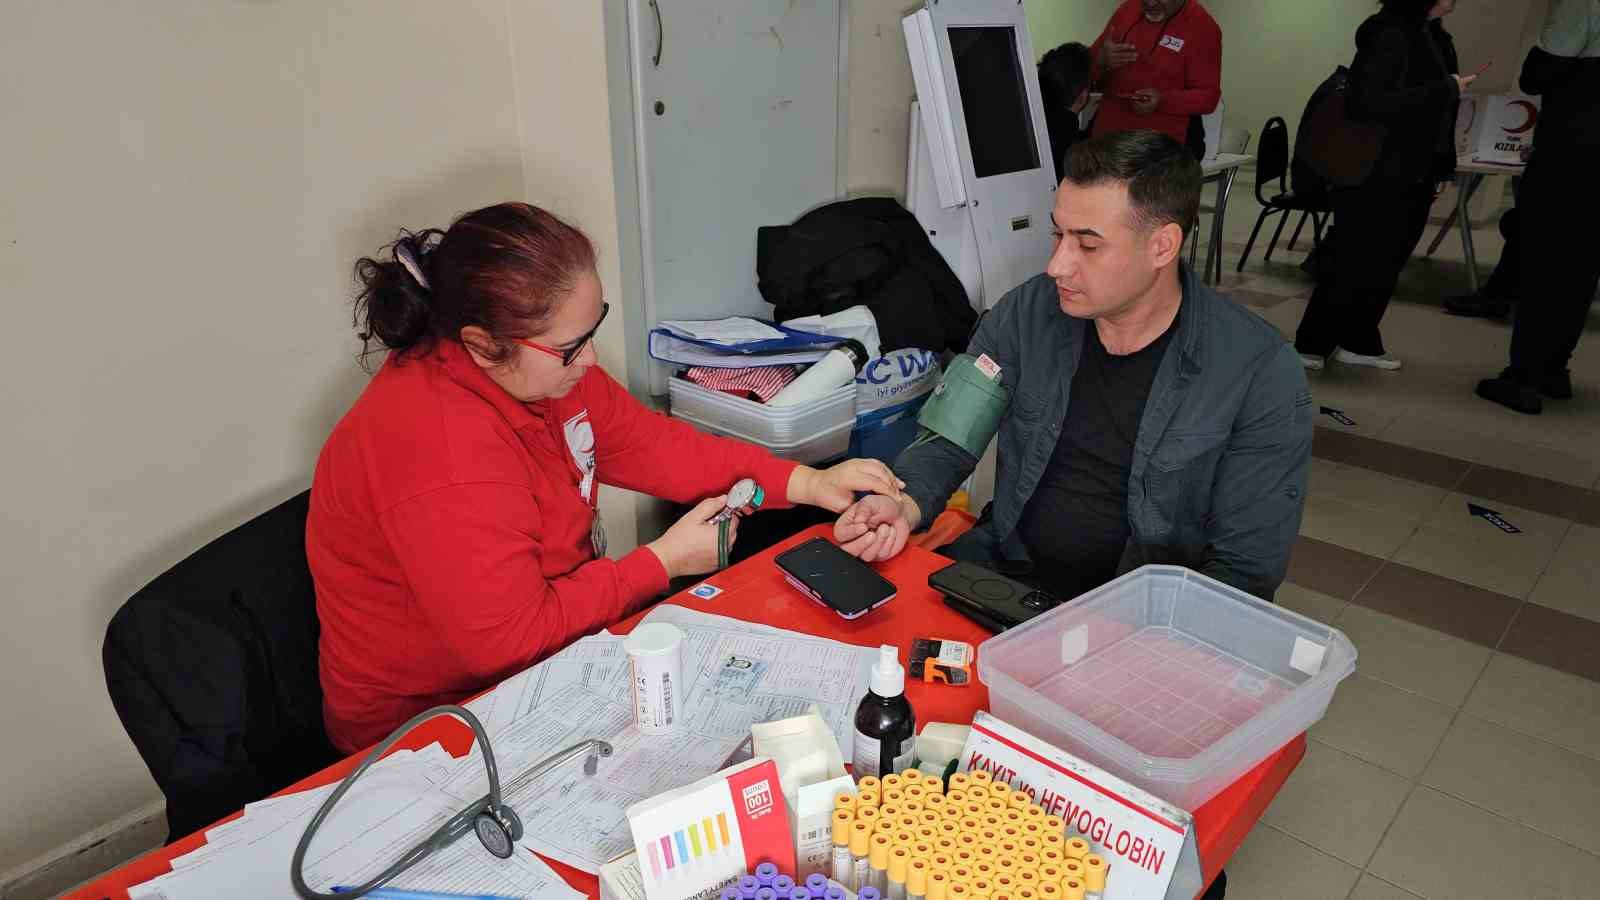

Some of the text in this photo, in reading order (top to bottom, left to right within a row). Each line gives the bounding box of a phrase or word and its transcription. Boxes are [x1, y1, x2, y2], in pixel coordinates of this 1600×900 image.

[748, 792, 769, 809] 100
[968, 751, 1017, 785] KAYIT
[1040, 789, 1165, 874] HEMOGLOBİN
